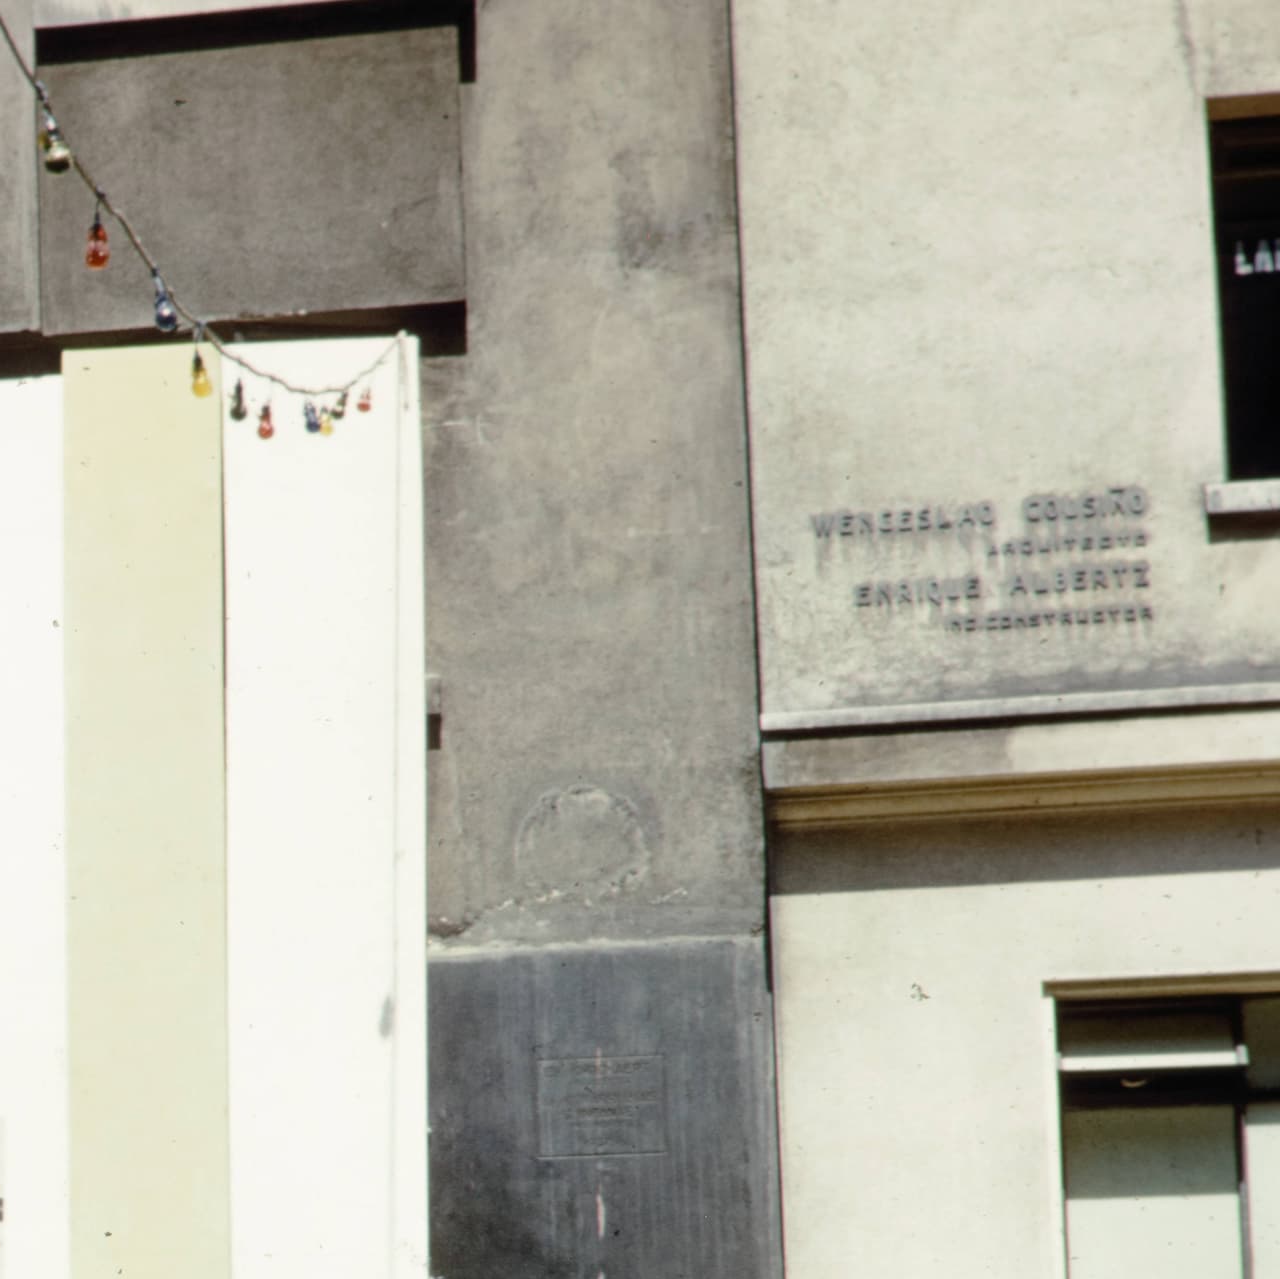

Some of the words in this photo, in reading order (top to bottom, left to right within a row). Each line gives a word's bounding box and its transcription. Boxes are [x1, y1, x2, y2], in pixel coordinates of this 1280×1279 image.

[809, 501, 995, 539] WENCESLAO
[986, 531, 1149, 557] ARQUITECTO
[855, 574, 981, 610] ENRIQUE
